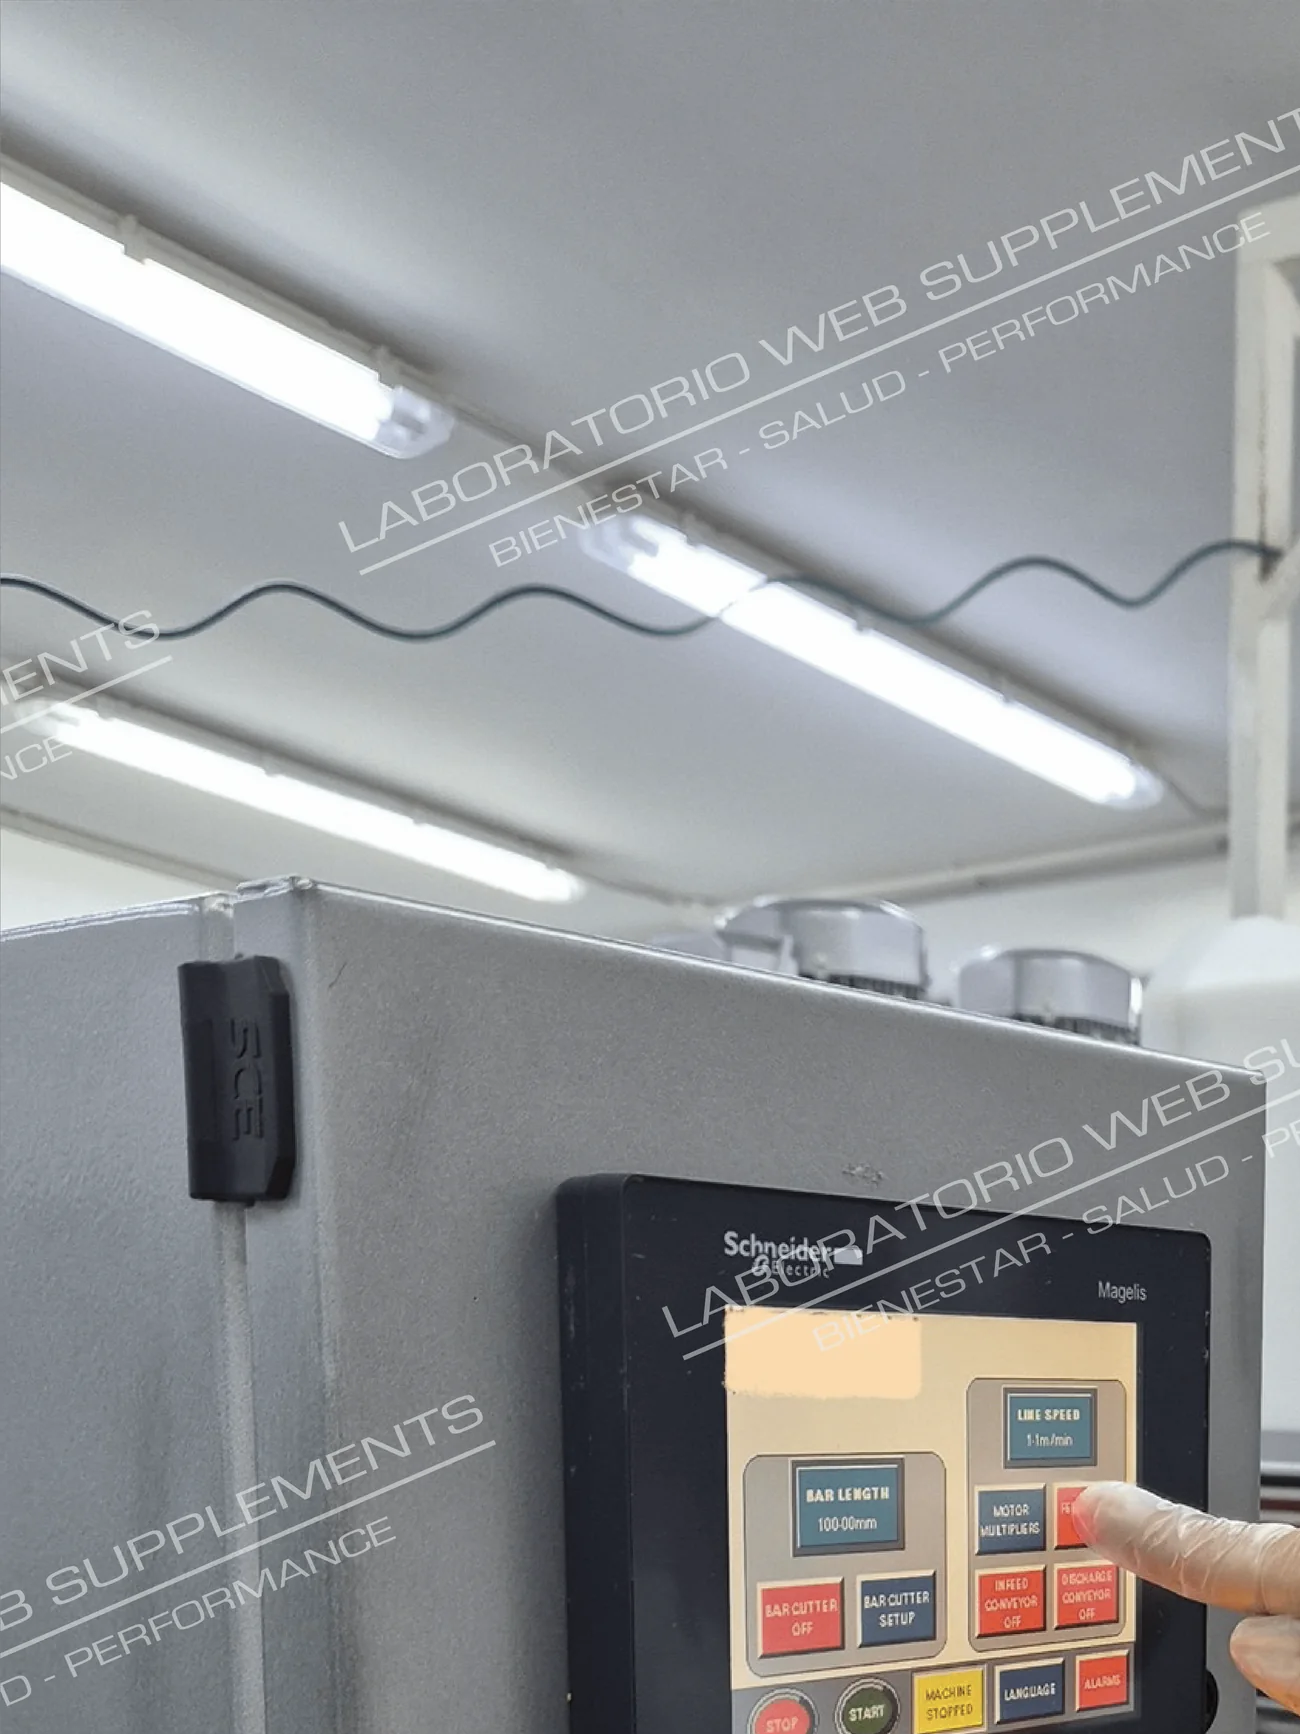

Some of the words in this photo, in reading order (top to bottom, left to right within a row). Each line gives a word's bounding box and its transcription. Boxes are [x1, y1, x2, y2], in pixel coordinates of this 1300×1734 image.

[723, 1231, 832, 1262] Schneider
[1098, 1281, 1147, 1303] Magelis
[1016, 1408, 1042, 1421] LINE
[1044, 1408, 1081, 1421] SPEED
[805, 1488, 834, 1502] BAR
[837, 1486, 890, 1502] LENGTH
[993, 1504, 1030, 1518] MOTOR
[980, 1523, 1041, 1538] MULTIPLIERS
[994, 1577, 1029, 1591] INFEED
[1061, 1570, 1113, 1586] DISCHARGE
[863, 1594, 887, 1609] BAR
[888, 1591, 930, 1606] CUTTER
[984, 1595, 1038, 1611] CONVEYOR
[1061, 1588, 1112, 1604] CONVEYOR
[765, 1602, 790, 1618] BAR
[791, 1598, 839, 1615] CUTTER
[1078, 1607, 1096, 1620] OFF
[878, 1611, 916, 1628] SETUP
[1003, 1616, 1022, 1629] OFF
[791, 1621, 814, 1636] OFF
[1083, 1673, 1122, 1690] ALARMS
[925, 1684, 972, 1701] MACHINE
[1004, 1682, 1057, 1702] LANGUAGE
[849, 1703, 885, 1722] START
[925, 1703, 974, 1721] STOPPED
[765, 1717, 799, 1734] STOP
